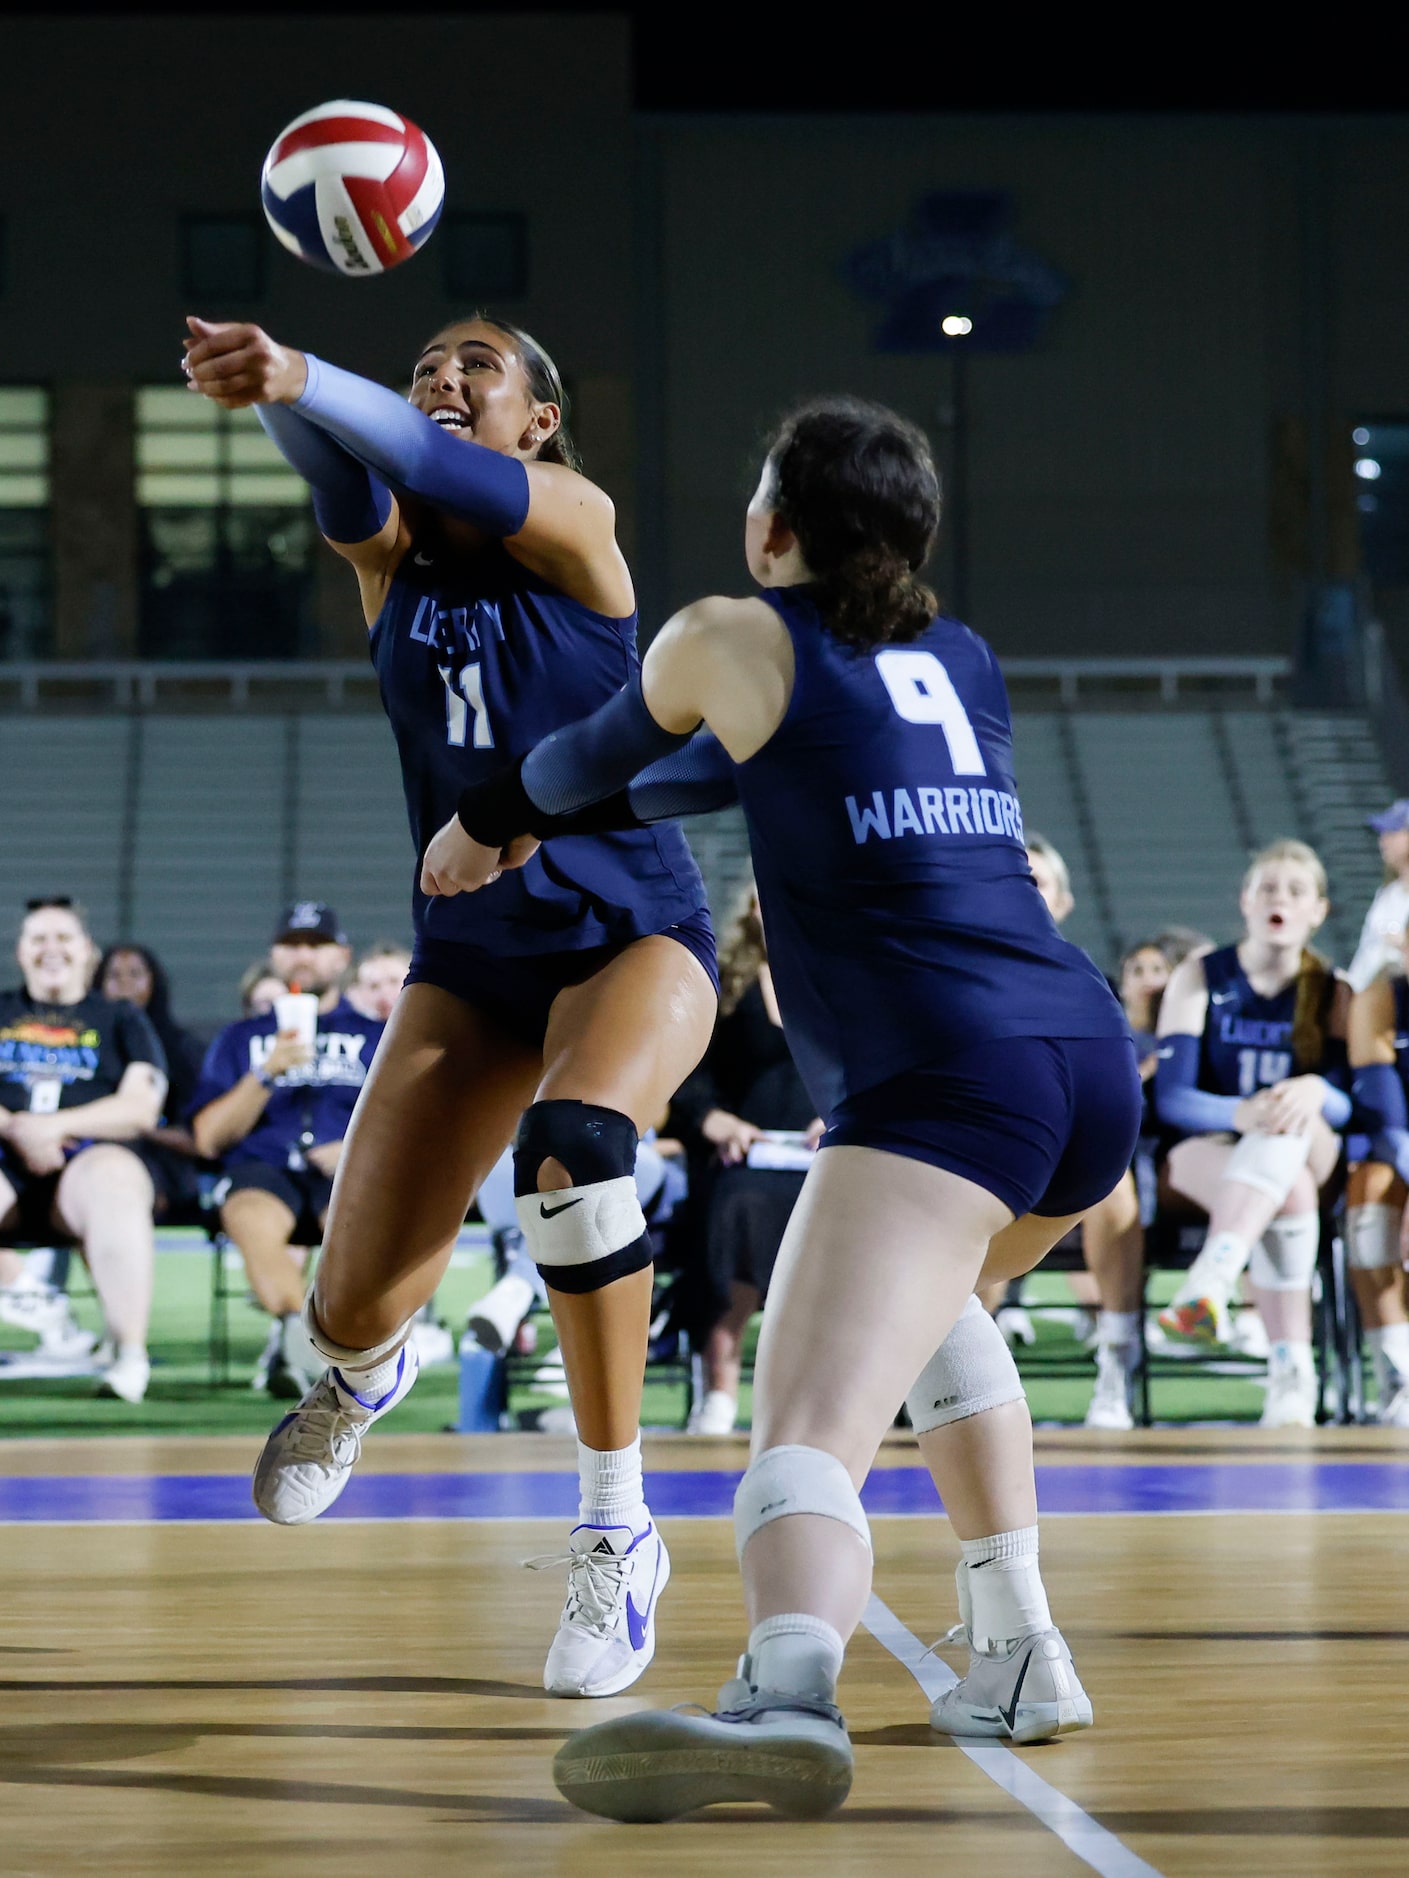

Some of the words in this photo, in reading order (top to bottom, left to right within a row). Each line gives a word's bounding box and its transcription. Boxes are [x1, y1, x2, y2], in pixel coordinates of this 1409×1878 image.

[437, 661, 496, 750] 11
[875, 650, 987, 776] 9
[845, 786, 1024, 845] WARRIORS
